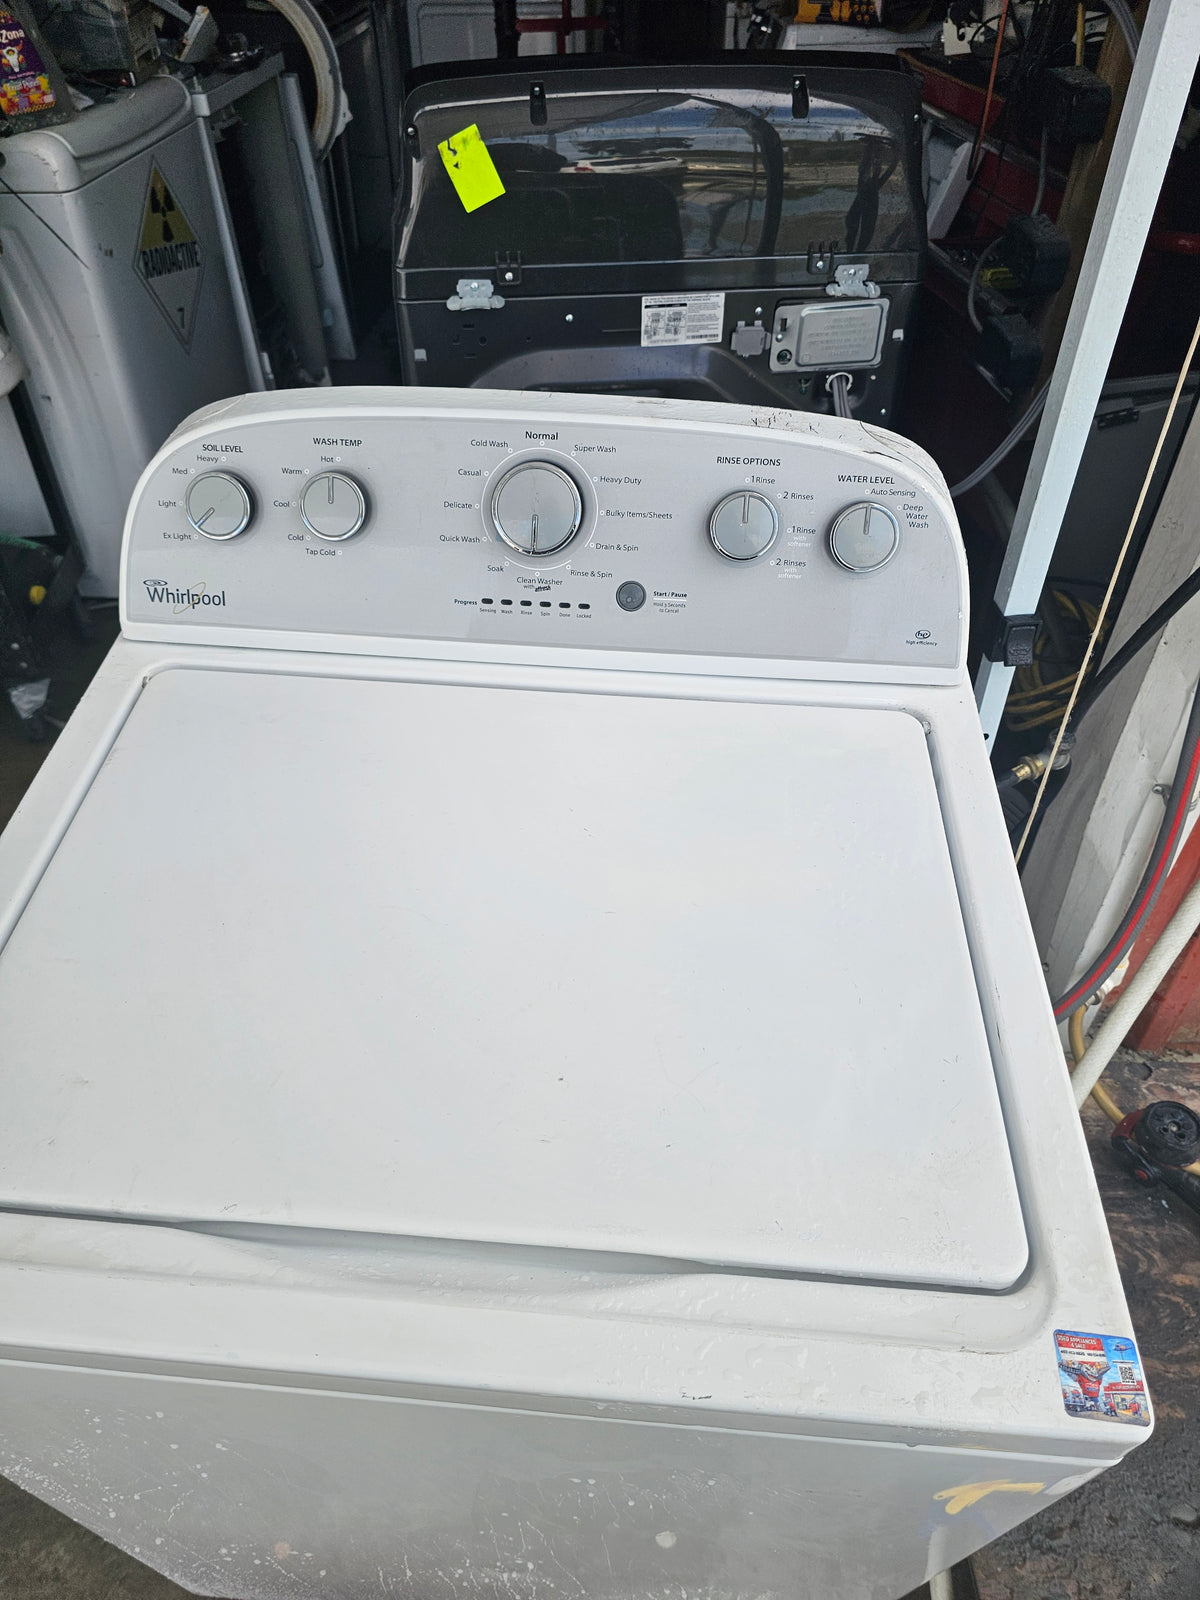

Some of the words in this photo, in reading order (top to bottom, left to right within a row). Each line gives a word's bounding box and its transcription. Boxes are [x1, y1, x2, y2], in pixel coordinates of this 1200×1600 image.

[142, 242, 201, 279] RADIOACTIVE
[525, 431, 558, 440] Normal
[313, 437, 338, 446] WASH
[340, 439, 362, 447] TEMP
[471, 439, 488, 447] Cold
[490, 440, 509, 448] Wash
[202, 443, 221, 453] SOIL
[222, 445, 243, 454] LEVEL
[574, 444, 595, 453] Super
[597, 445, 616, 453] Wash
[197, 455, 219, 464] Heavy
[320, 455, 334, 463] Hot
[717, 456, 740, 465] RINSE
[742, 457, 781, 466] OPTIONS
[172, 467, 188, 475] Med
[458, 468, 481, 477] Casual
[600, 475, 622, 485] Heavy
[624, 476, 642, 486] Duty
[756, 476, 775, 484] Rinse
[838, 475, 867, 483] WATER
[870, 476, 895, 484] LEVEL
[783, 491, 789, 499] 2
[889, 489, 916, 498] Sensing
[158, 499, 176, 508] Light
[273, 500, 290, 508] Cool
[444, 501, 472, 509] Delicate
[903, 504, 923, 512] Deep
[606, 510, 625, 519] Bulky
[626, 510, 673, 520] Items/Sheets
[796, 527, 816, 535] Rinse
[174, 533, 191, 542] Light
[439, 535, 459, 543] Quick
[461, 535, 480, 543] Wash
[596, 543, 613, 551] Drain
[623, 544, 638, 553] Spin
[306, 549, 318, 557] Tap
[776, 558, 781, 566] 2
[784, 559, 806, 567] Rinses
[487, 565, 504, 573] Soak
[570, 570, 588, 578] Rinse
[596, 572, 612, 580] Spin
[777, 572, 802, 580] softener
[146, 587, 226, 609] Whirlpool
